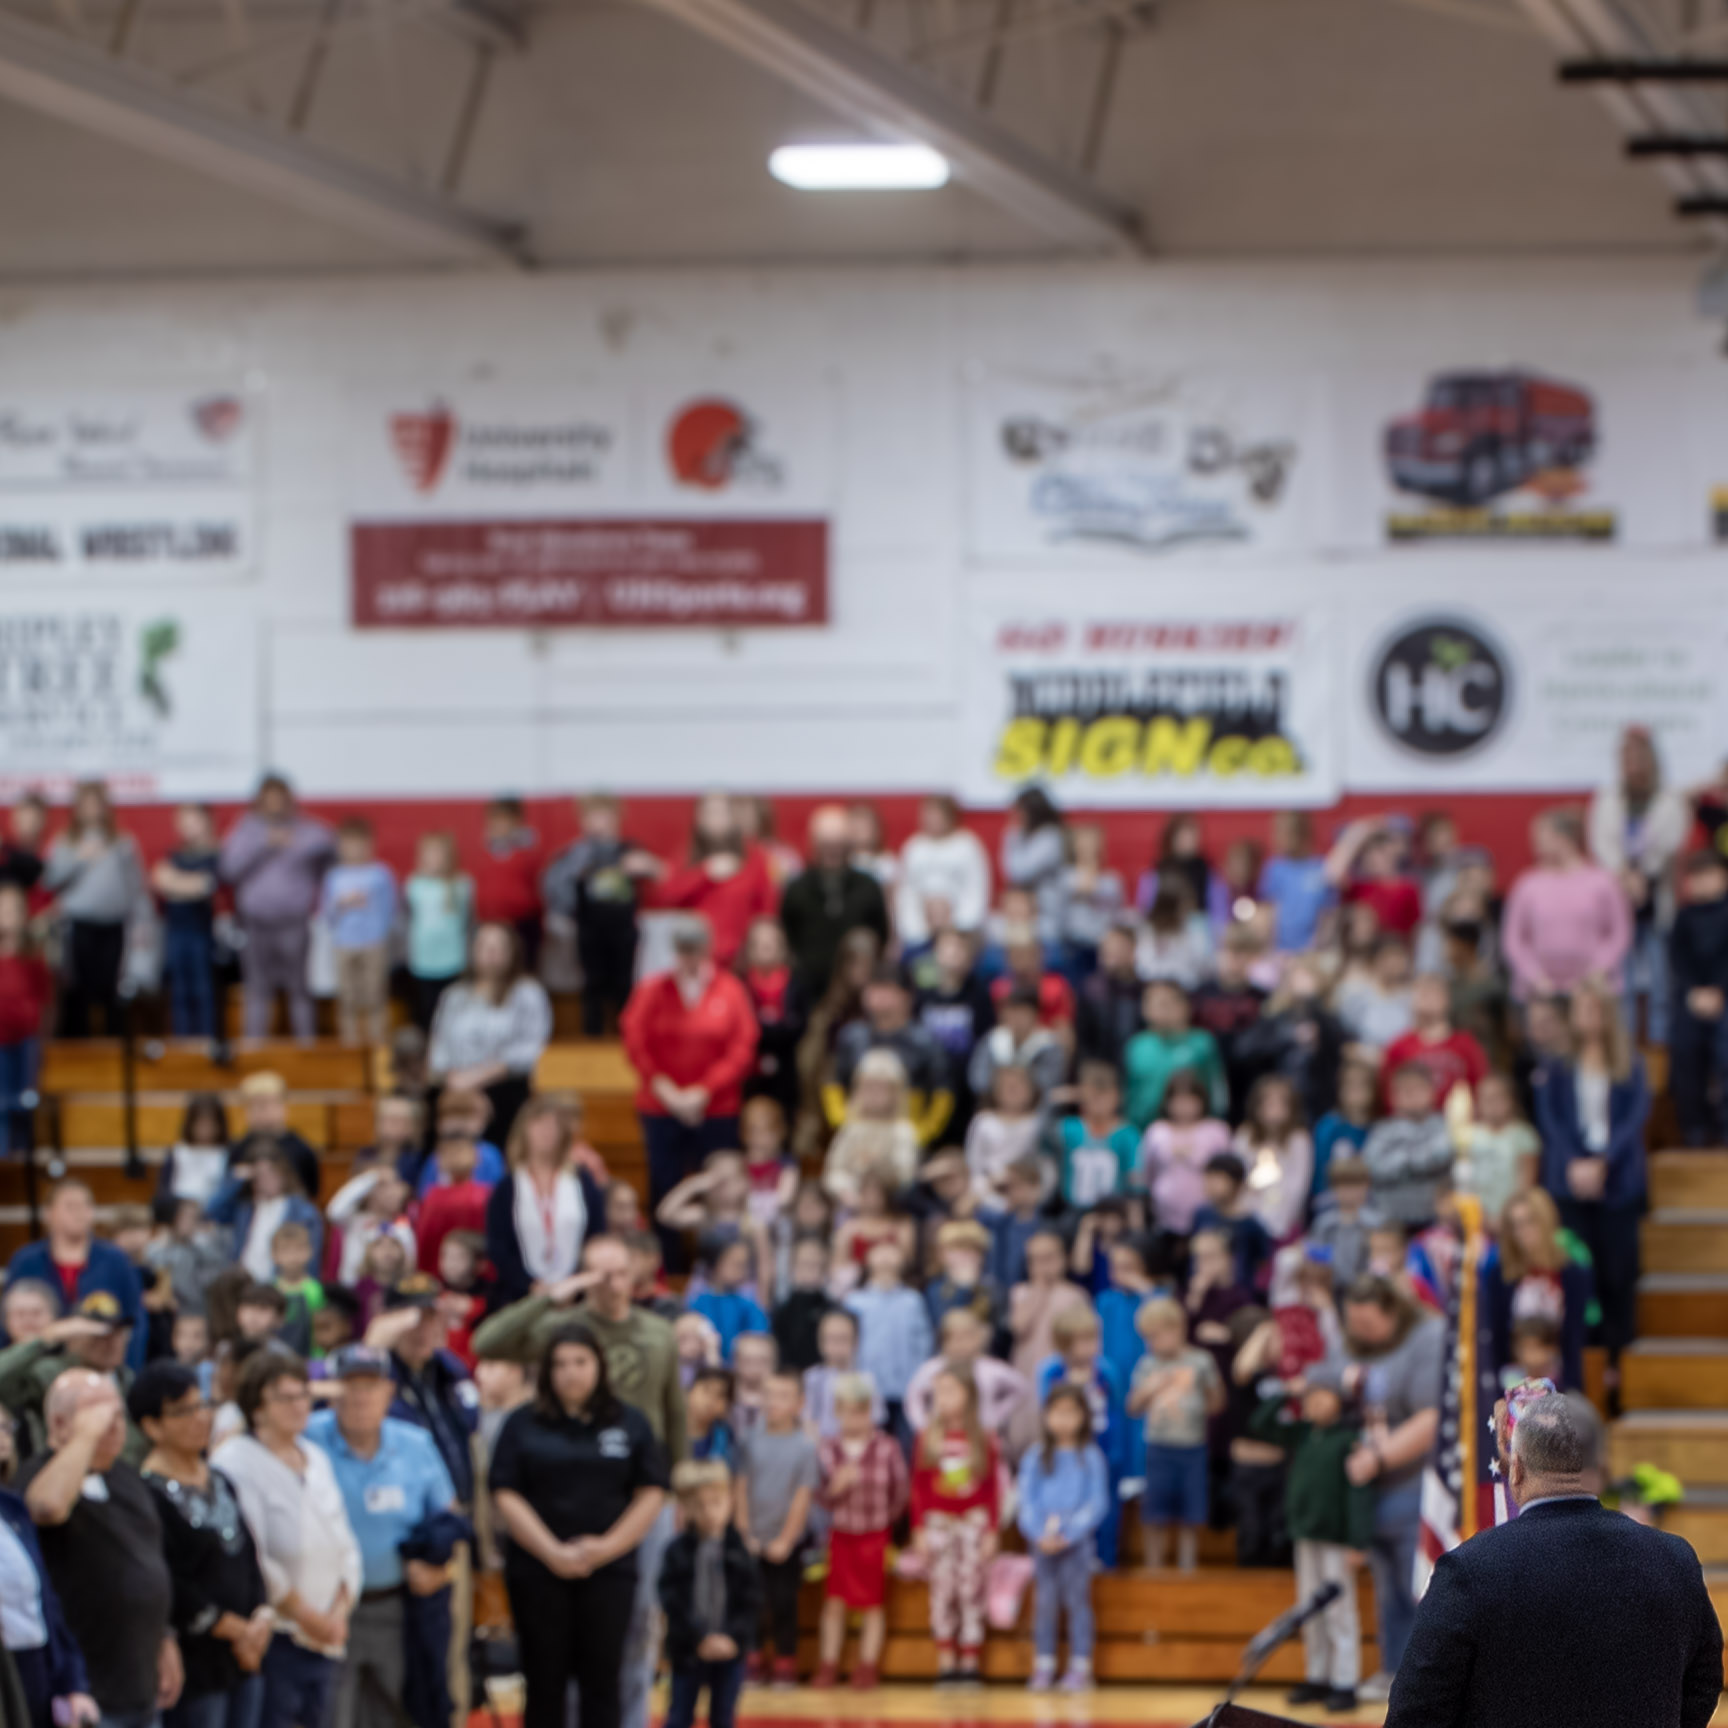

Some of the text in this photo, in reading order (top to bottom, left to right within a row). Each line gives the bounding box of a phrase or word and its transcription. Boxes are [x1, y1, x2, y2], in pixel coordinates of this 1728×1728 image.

[464, 421, 611, 457] University
[464, 455, 599, 487] Hospitals
[77, 522, 240, 562] WRESTLING
[1389, 665, 1496, 732] HC
[992, 720, 1210, 782] SIGN
